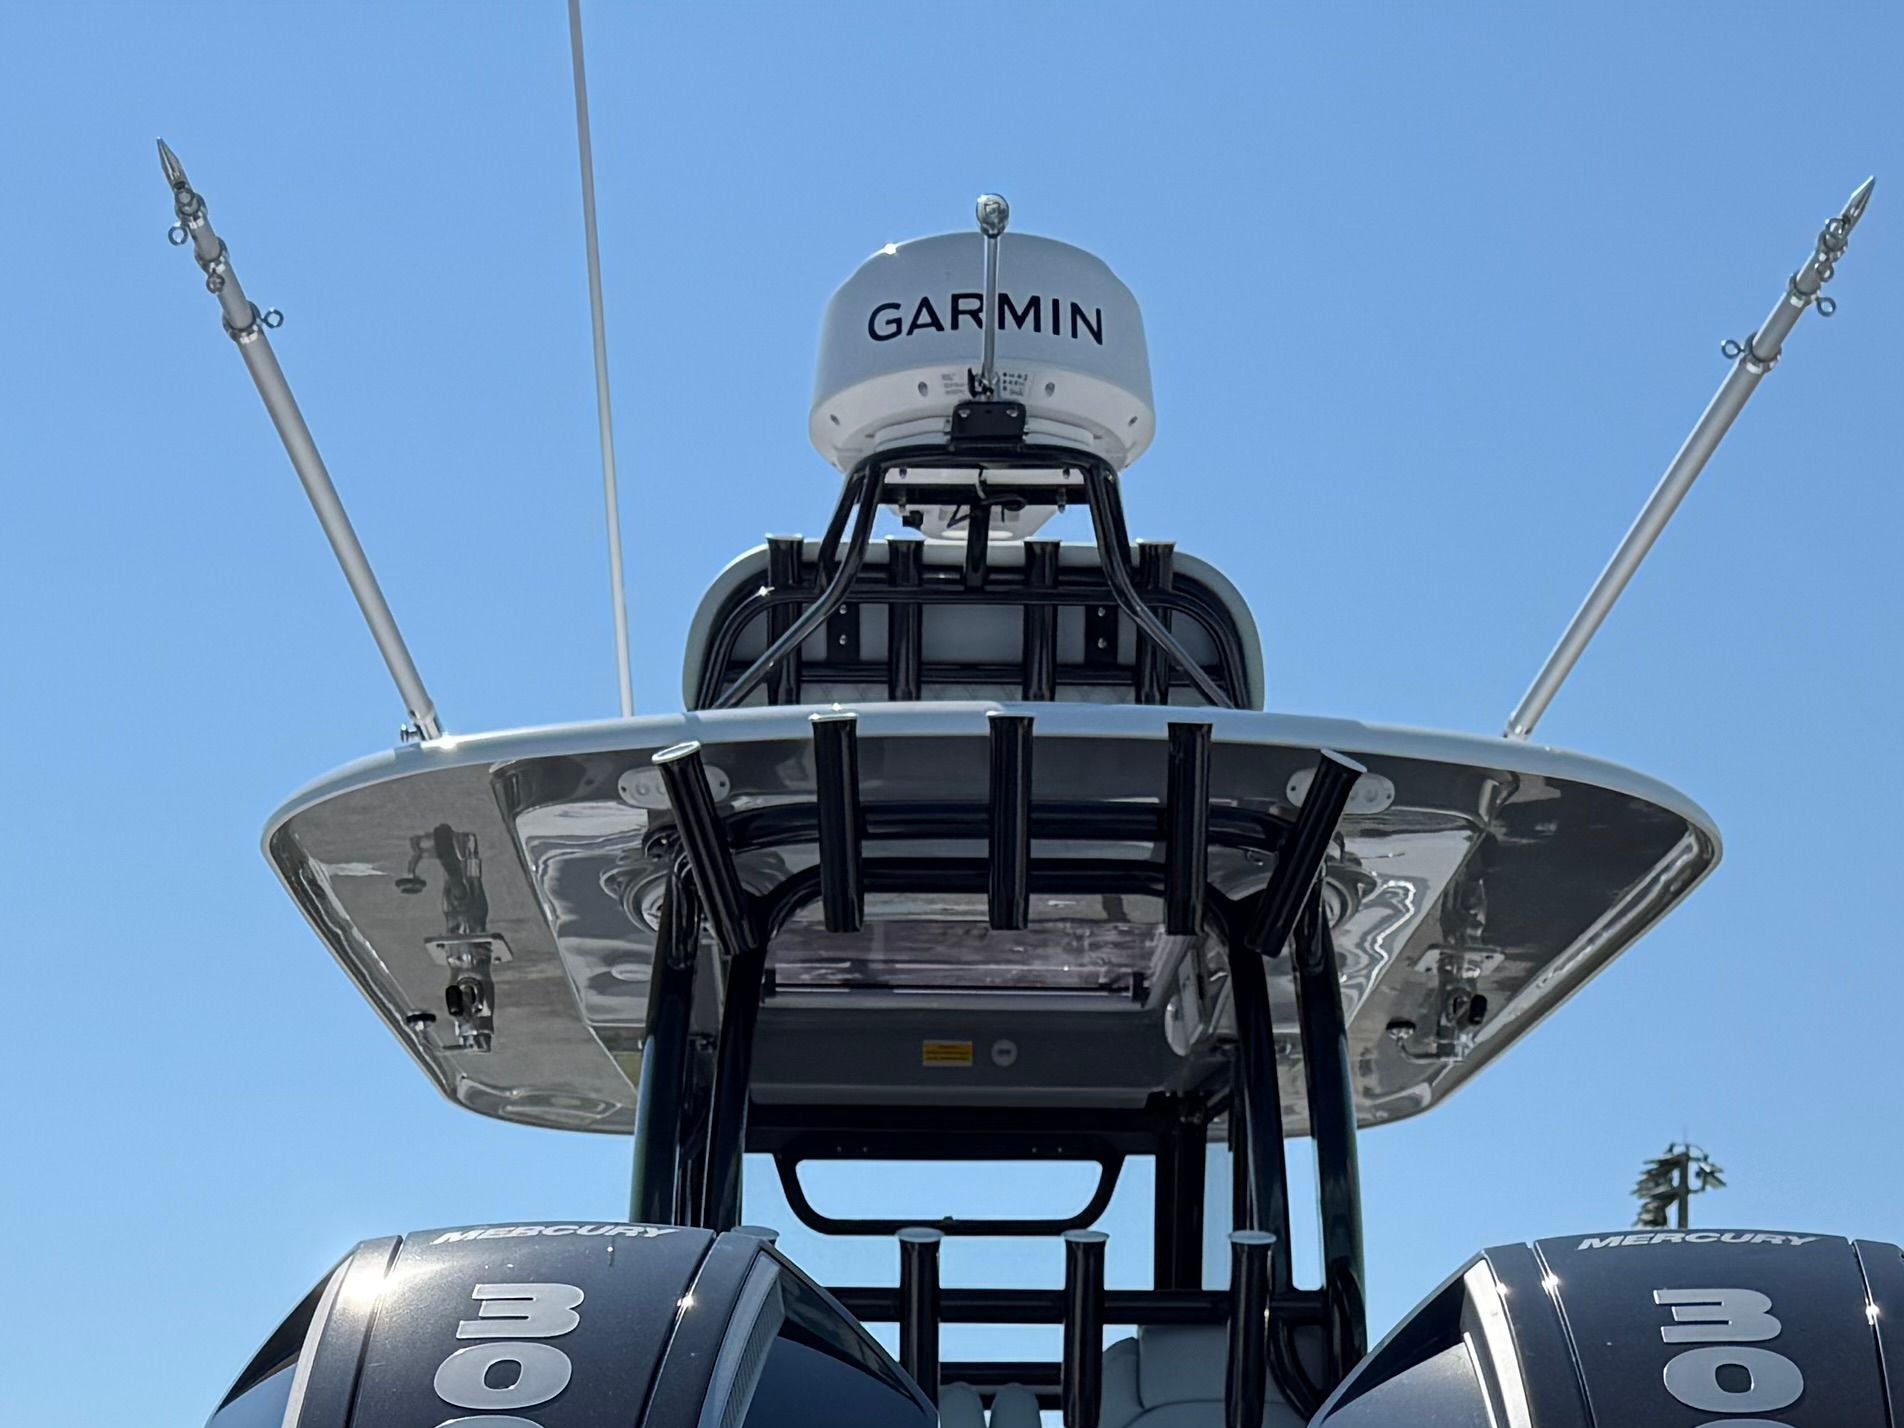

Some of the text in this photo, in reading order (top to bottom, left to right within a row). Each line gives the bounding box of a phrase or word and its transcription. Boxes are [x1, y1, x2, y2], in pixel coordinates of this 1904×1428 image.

[868, 292, 1103, 346] GARMIN
[429, 1224, 682, 1246] MERCURY
[1576, 1231, 1826, 1250] MERCURY
